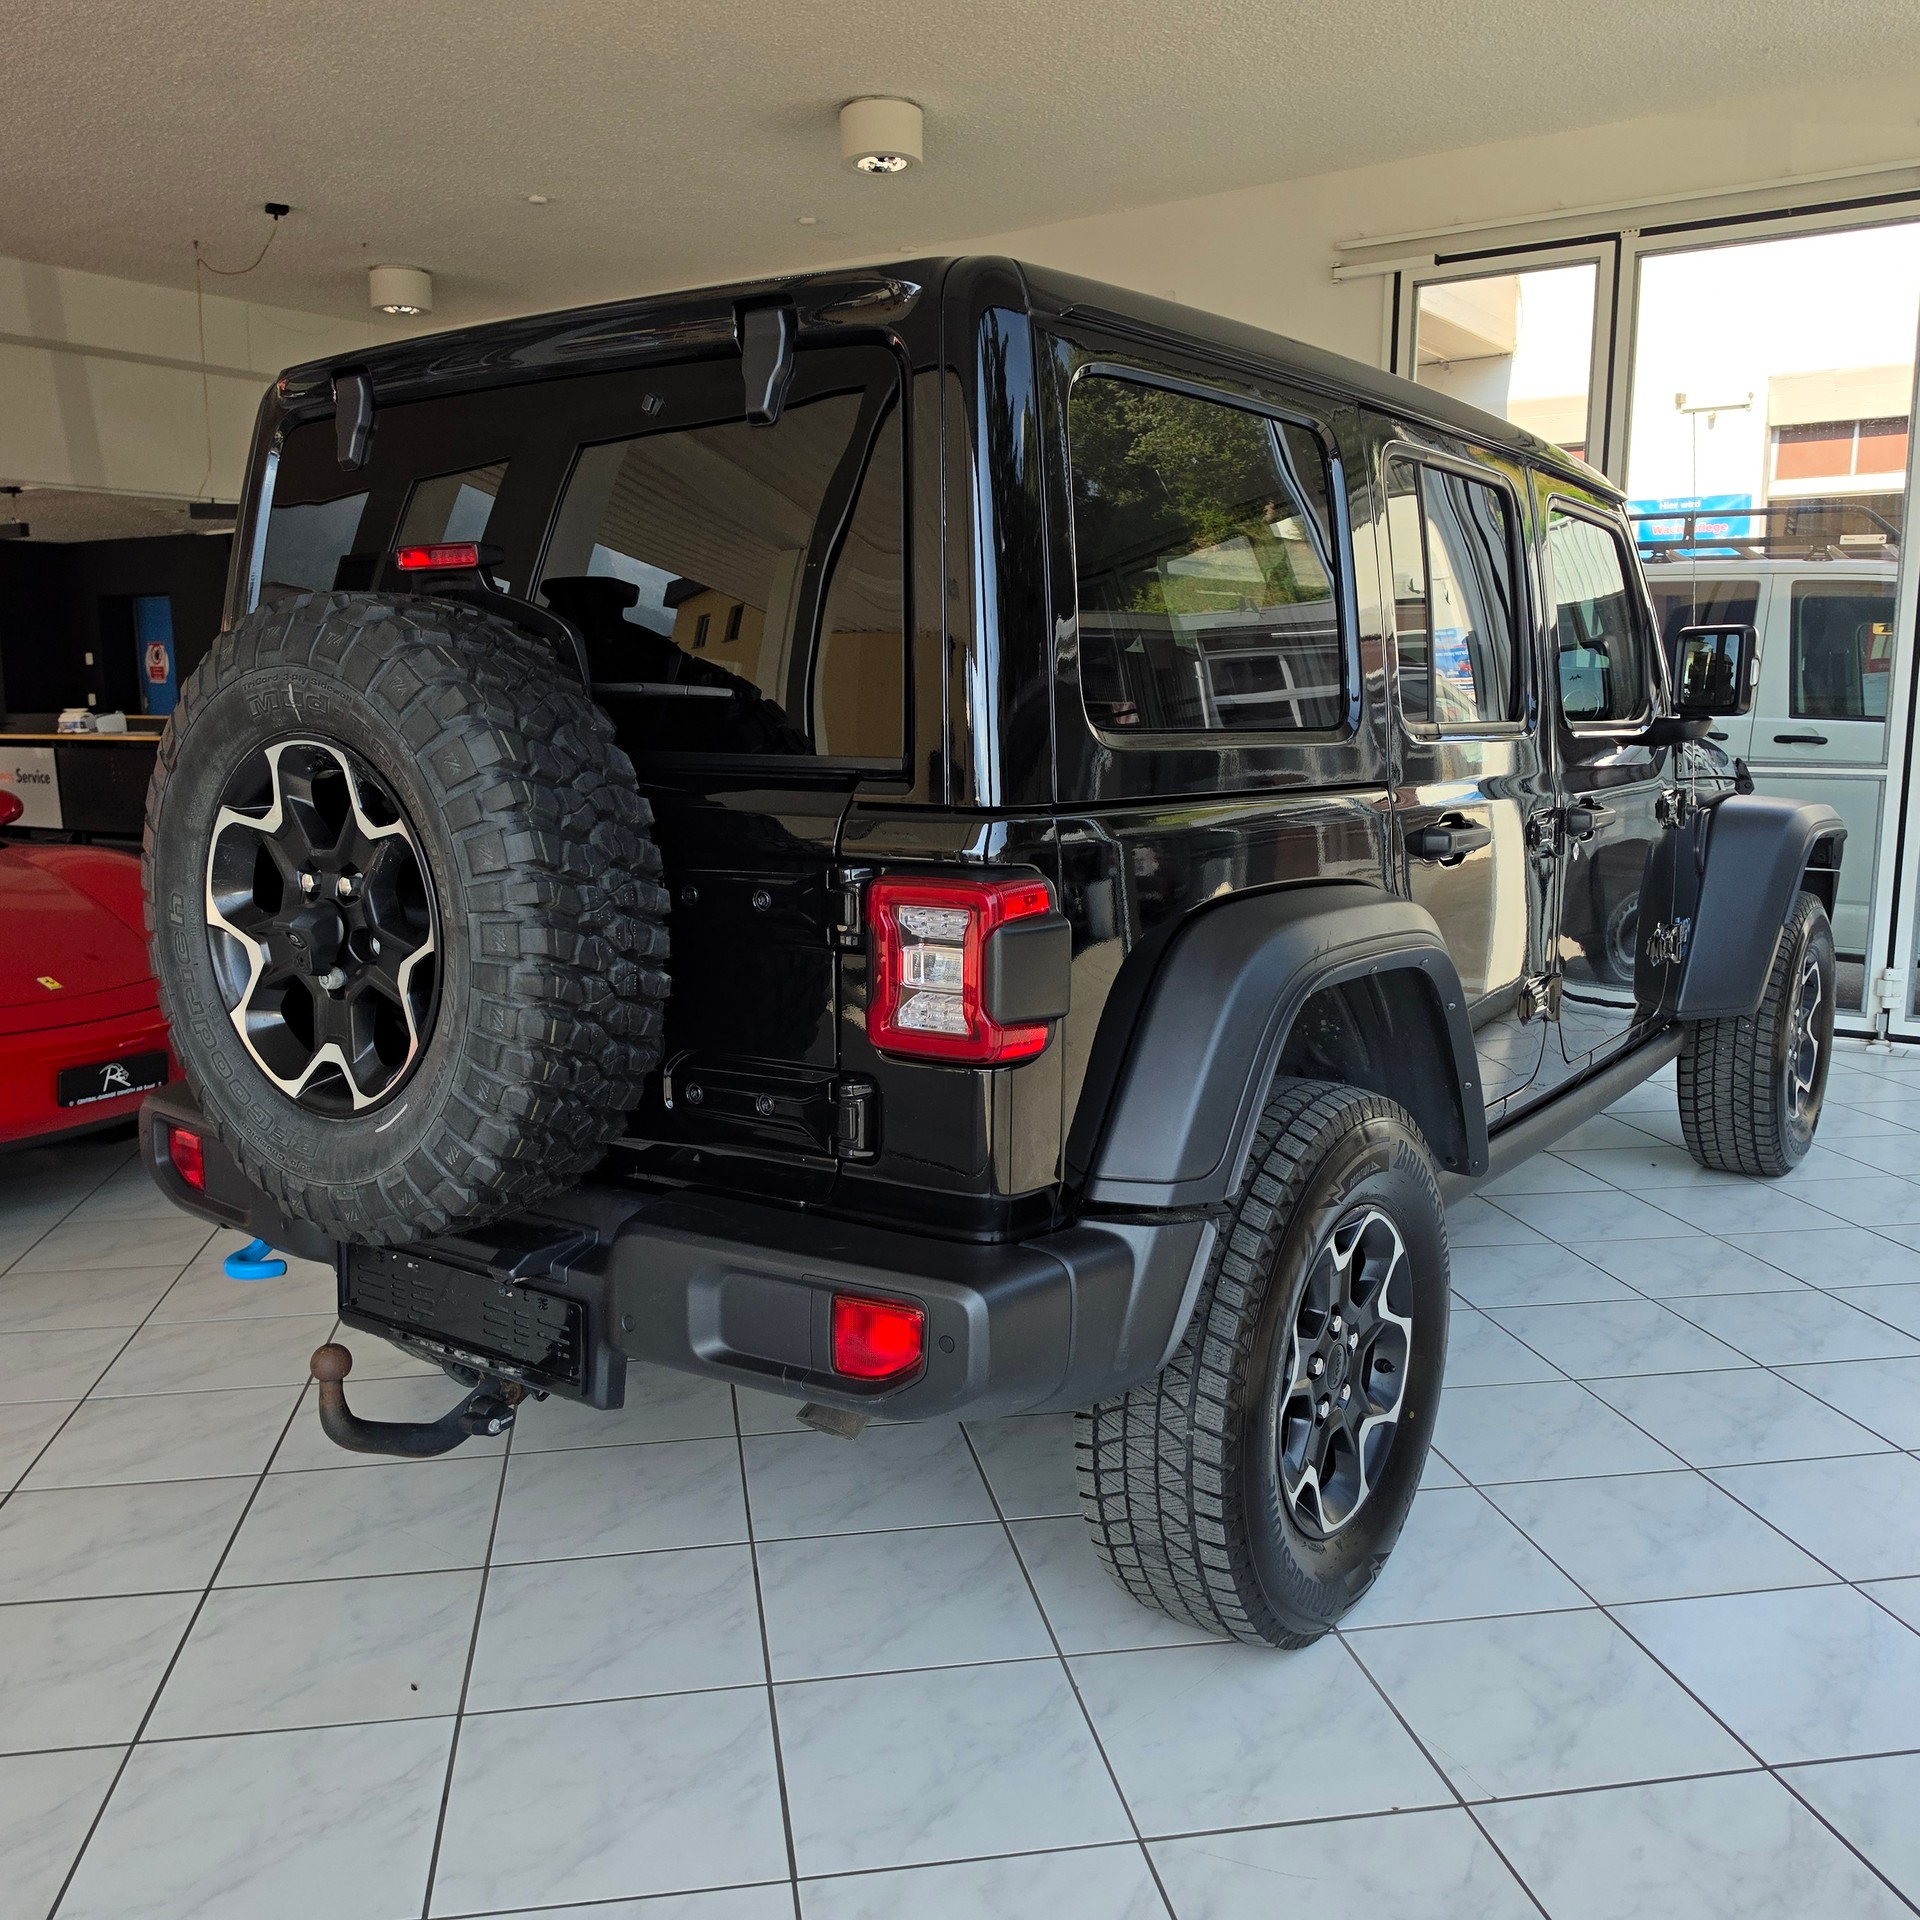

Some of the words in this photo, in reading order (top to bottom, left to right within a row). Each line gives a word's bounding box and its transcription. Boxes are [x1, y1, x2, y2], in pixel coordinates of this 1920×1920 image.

[1660, 501, 1678, 510] Hier
[1681, 500, 1701, 509] wird
[16, 768, 51, 784] Service
[1393, 1138, 1450, 1288] BRIDGESTONE
[1262, 1473, 1337, 1617] BRIDGESTONE
